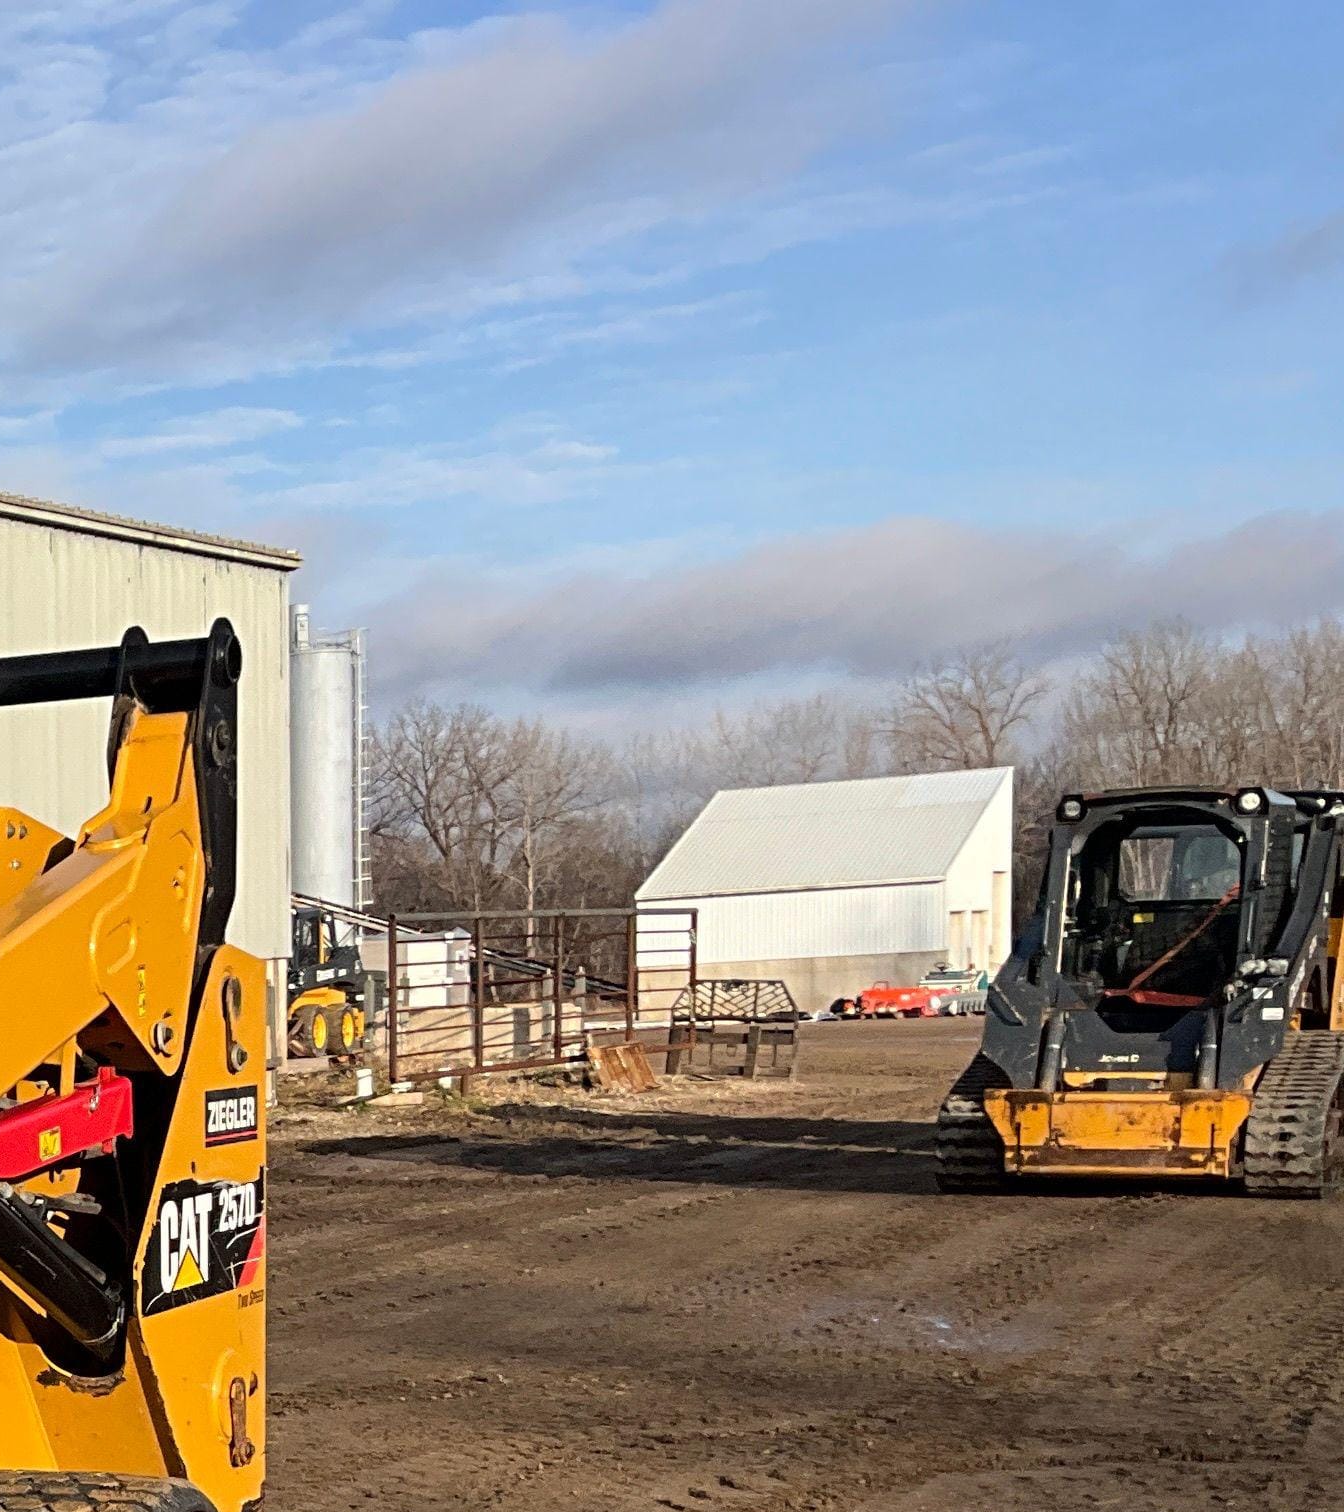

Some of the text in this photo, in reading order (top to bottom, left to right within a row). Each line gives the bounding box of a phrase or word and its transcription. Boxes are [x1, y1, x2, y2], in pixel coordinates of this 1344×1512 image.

[207, 1096, 256, 1133] ZIEGLER
[218, 1182, 256, 1233] 257D
[160, 1192, 213, 1294] CAT
